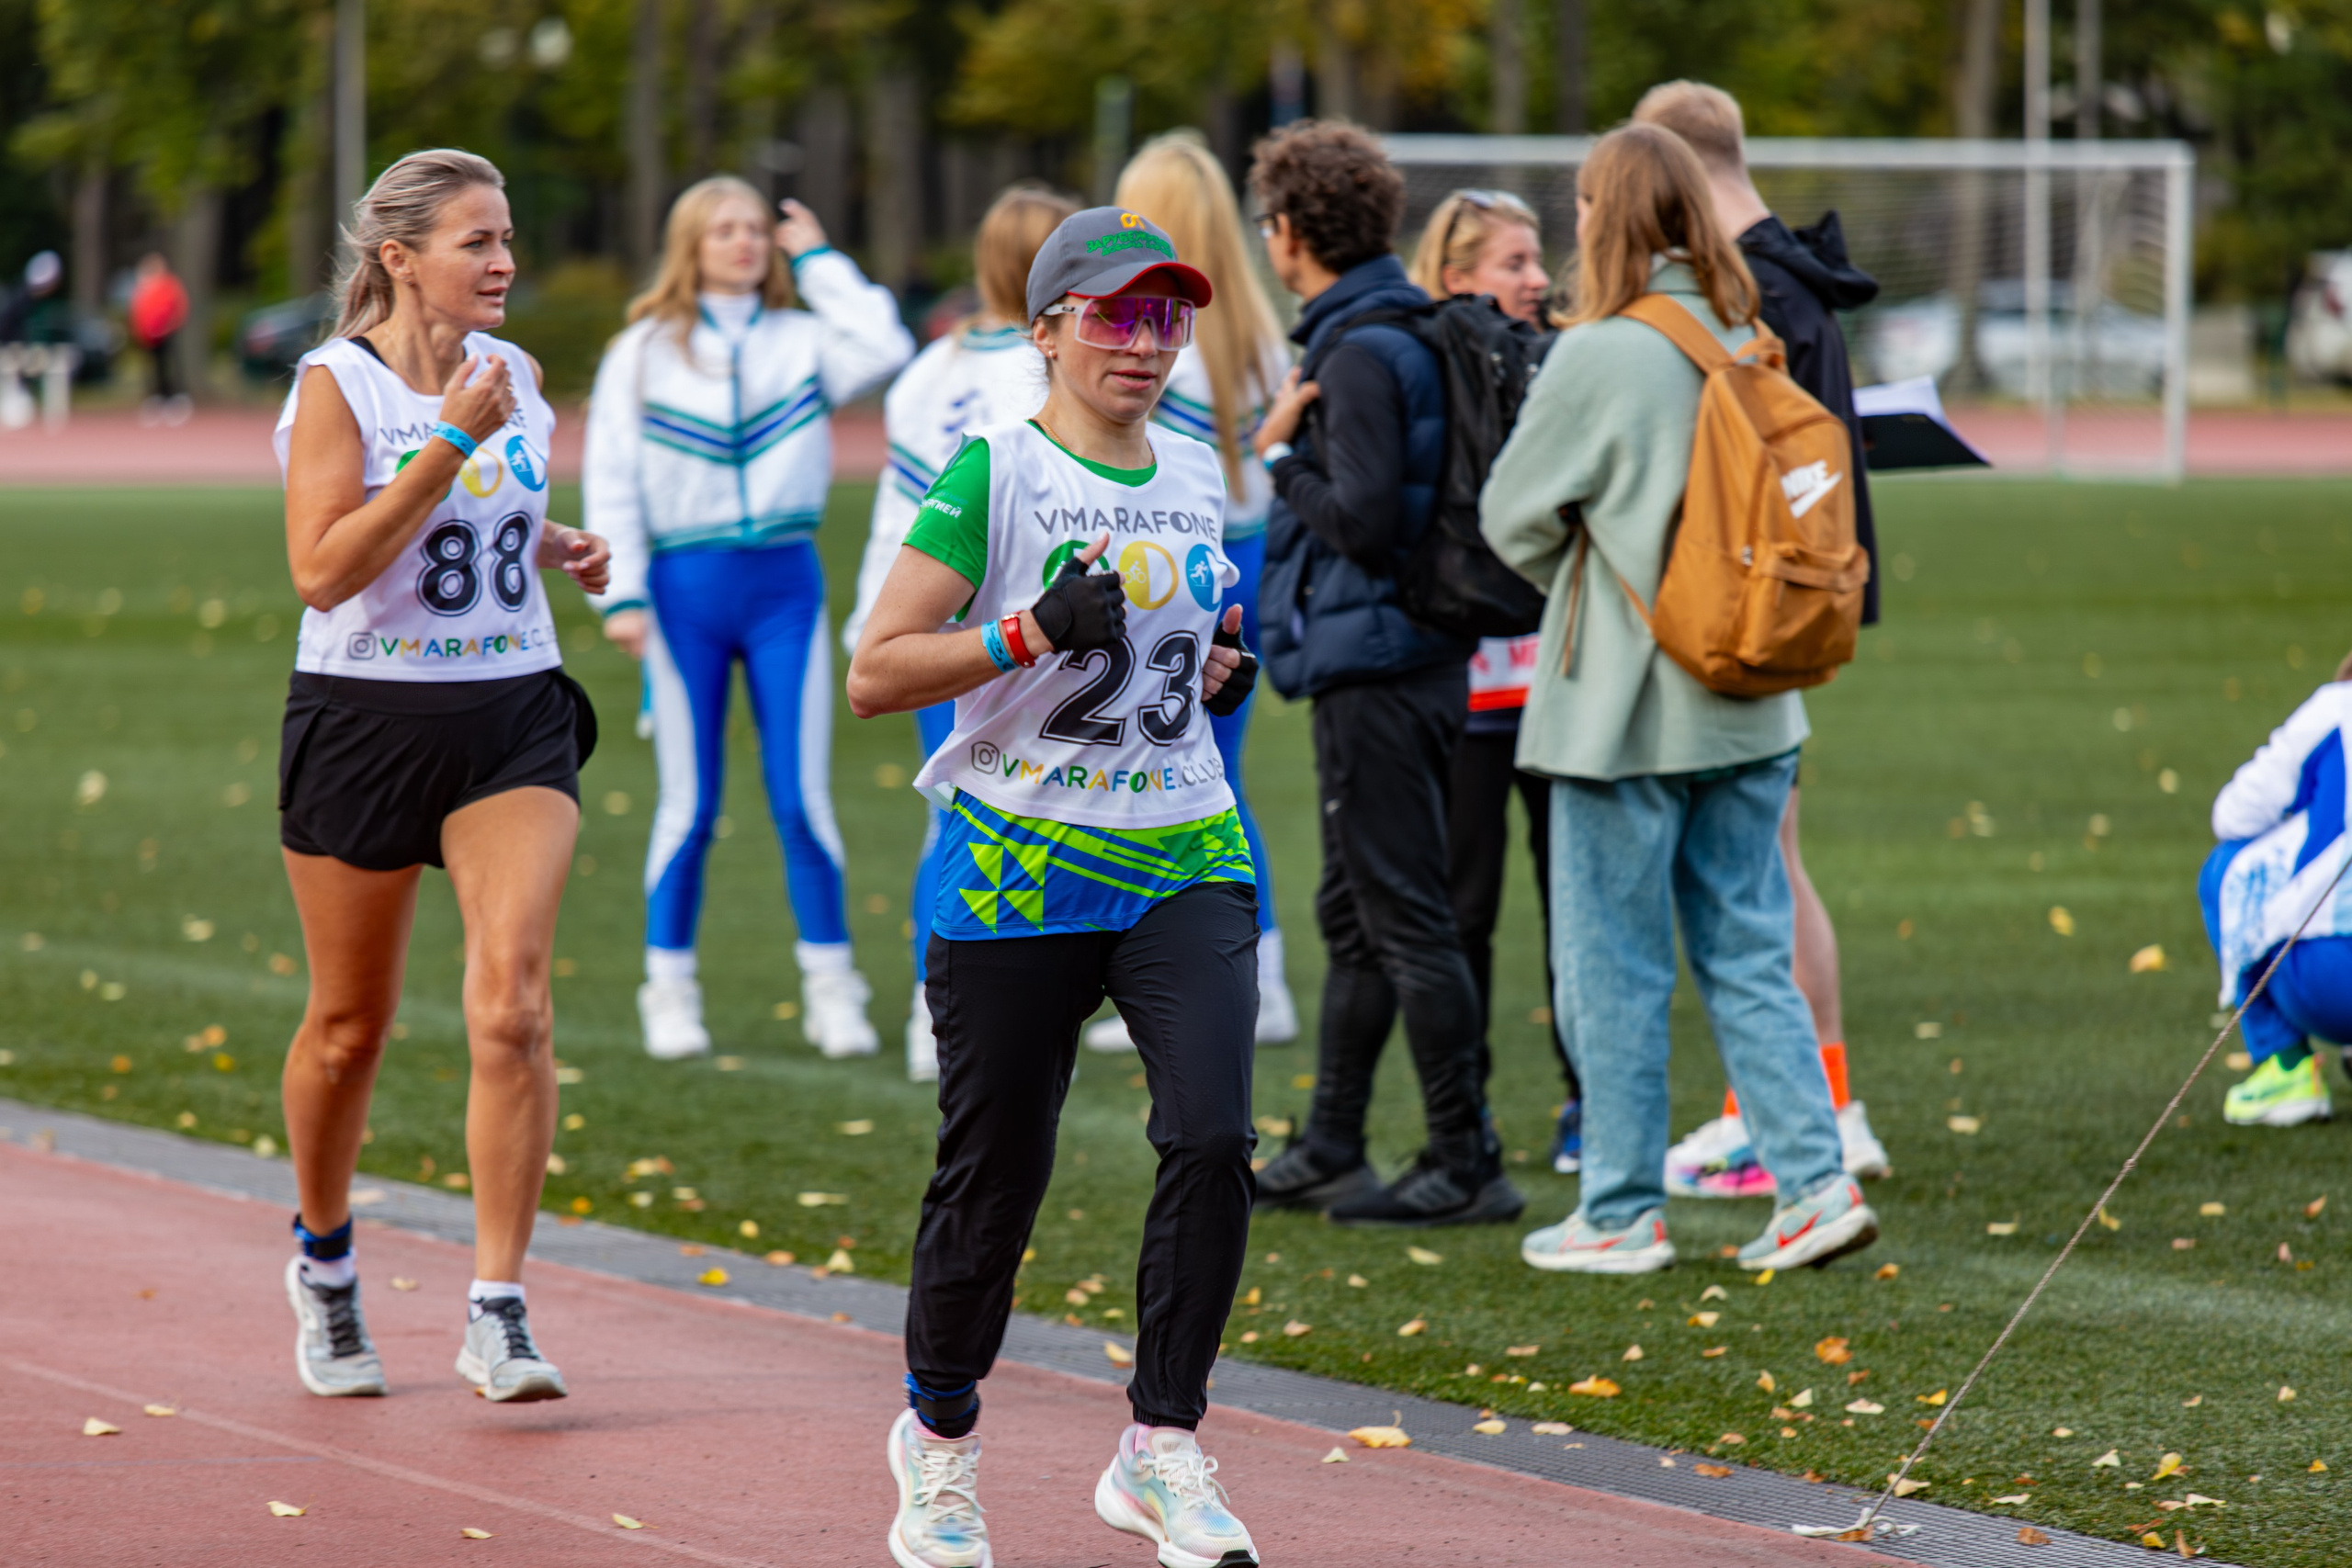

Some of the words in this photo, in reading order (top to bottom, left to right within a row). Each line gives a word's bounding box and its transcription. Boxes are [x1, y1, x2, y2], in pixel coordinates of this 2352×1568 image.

[1034, 506, 1218, 543] VMARAFONE
[417, 511, 534, 616] 88
[1039, 629, 1203, 747] 23
[1001, 753, 1224, 794] VMARAFONE.CLUB
